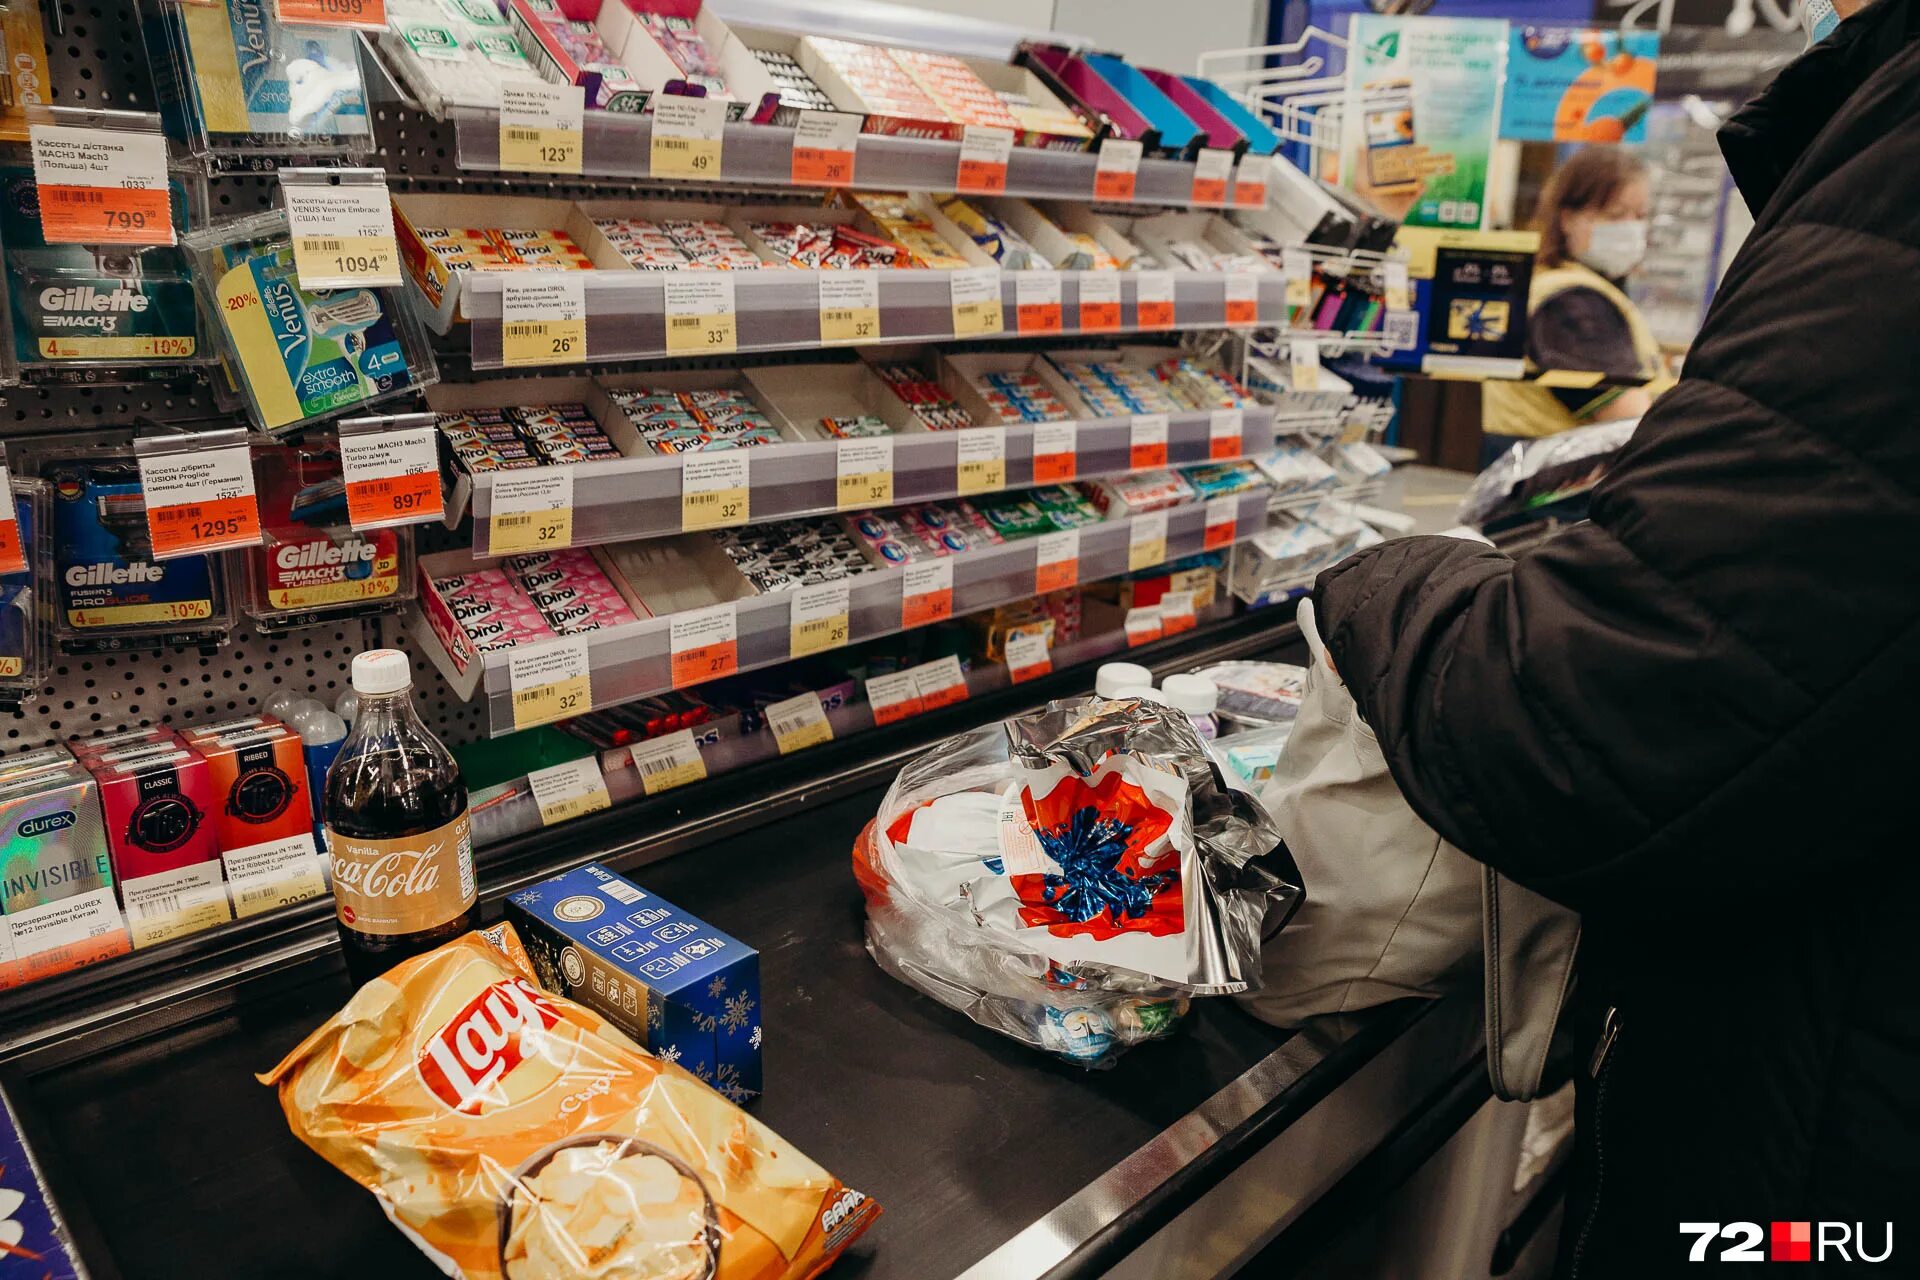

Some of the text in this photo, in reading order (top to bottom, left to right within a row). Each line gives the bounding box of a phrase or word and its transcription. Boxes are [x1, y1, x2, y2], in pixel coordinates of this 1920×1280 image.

[319, 0, 362, 14] 1099
[38, 138, 124, 152] Кассеты д/станка
[39, 149, 108, 161] MACH3 Mach3
[540, 147, 566, 162] 123
[40, 160, 109, 172] (Польша) 4шт
[692, 156, 707, 169] 49
[120, 180, 146, 190] 1033
[292, 206, 380, 214] VENUS Venus Embrace
[104, 210, 146, 228] 799
[358, 228, 378, 236] 1152
[504, 229, 538, 241] Dirol
[515, 246, 552, 257] Dirol
[336, 256, 380, 272] 1094
[446, 260, 472, 270] irol
[40, 286, 149, 312] Gillette
[225, 293, 258, 312] -20%
[56, 315, 117, 332] MACH3
[274, 282, 308, 359] Venus
[856, 323, 868, 336] 32
[708, 330, 722, 344] 33
[47, 340, 58, 356] 4
[552, 338, 570, 352] 26
[368, 354, 382, 371] 4
[302, 366, 337, 384] extra
[305, 371, 356, 395] smooth
[519, 407, 550, 420] Dirol
[622, 405, 654, 418] Dirol
[704, 406, 736, 420] Dirol
[530, 423, 562, 436] Dirol
[636, 420, 668, 434] Dirol
[717, 422, 746, 436] Dirol
[344, 438, 426, 454] Кассеты MACH3 Mach3
[544, 440, 574, 454] Dirol
[674, 438, 704, 454] Dirol
[346, 454, 367, 462] Turbo
[145, 462, 216, 476] Кассеты д/бритья
[346, 460, 388, 472] (Германия)
[146, 472, 210, 483] FUSION Proglide
[148, 482, 184, 492] сменные
[202, 474, 243, 488] (Германия)
[216, 490, 237, 500] 1524
[870, 488, 883, 498] 32
[393, 492, 424, 510] 897
[722, 504, 736, 518] 32
[191, 518, 238, 539] 1295
[538, 527, 556, 540] 32
[276, 540, 377, 570] Gillette
[517, 552, 551, 569] Dirol
[377, 560, 390, 570] 3D
[66, 562, 164, 586] Gillette
[290, 566, 346, 581] MACH3
[528, 569, 564, 587] Dirol
[764, 574, 791, 590] Dirol
[280, 592, 289, 606] 4
[540, 588, 576, 606] Dirol
[76, 612, 86, 624] 4
[454, 602, 492, 620] Dirol
[554, 604, 590, 623] Dirol
[466, 622, 504, 640] Dirol
[831, 629, 844, 640] 26
[711, 658, 724, 671] 27
[560, 694, 576, 709] 32
[244, 752, 268, 762] RIBBED
[144, 777, 173, 790] CLASSIC
[22, 812, 75, 834] durex
[346, 844, 380, 856] Vanilla
[227, 850, 278, 866] Презервативы
[246, 858, 270, 870] Ribbed
[3, 854, 108, 898] INVISIBLE
[11, 898, 102, 930] Презервативы DUREX
[14, 908, 99, 938] №12 Invisible (Китай)
